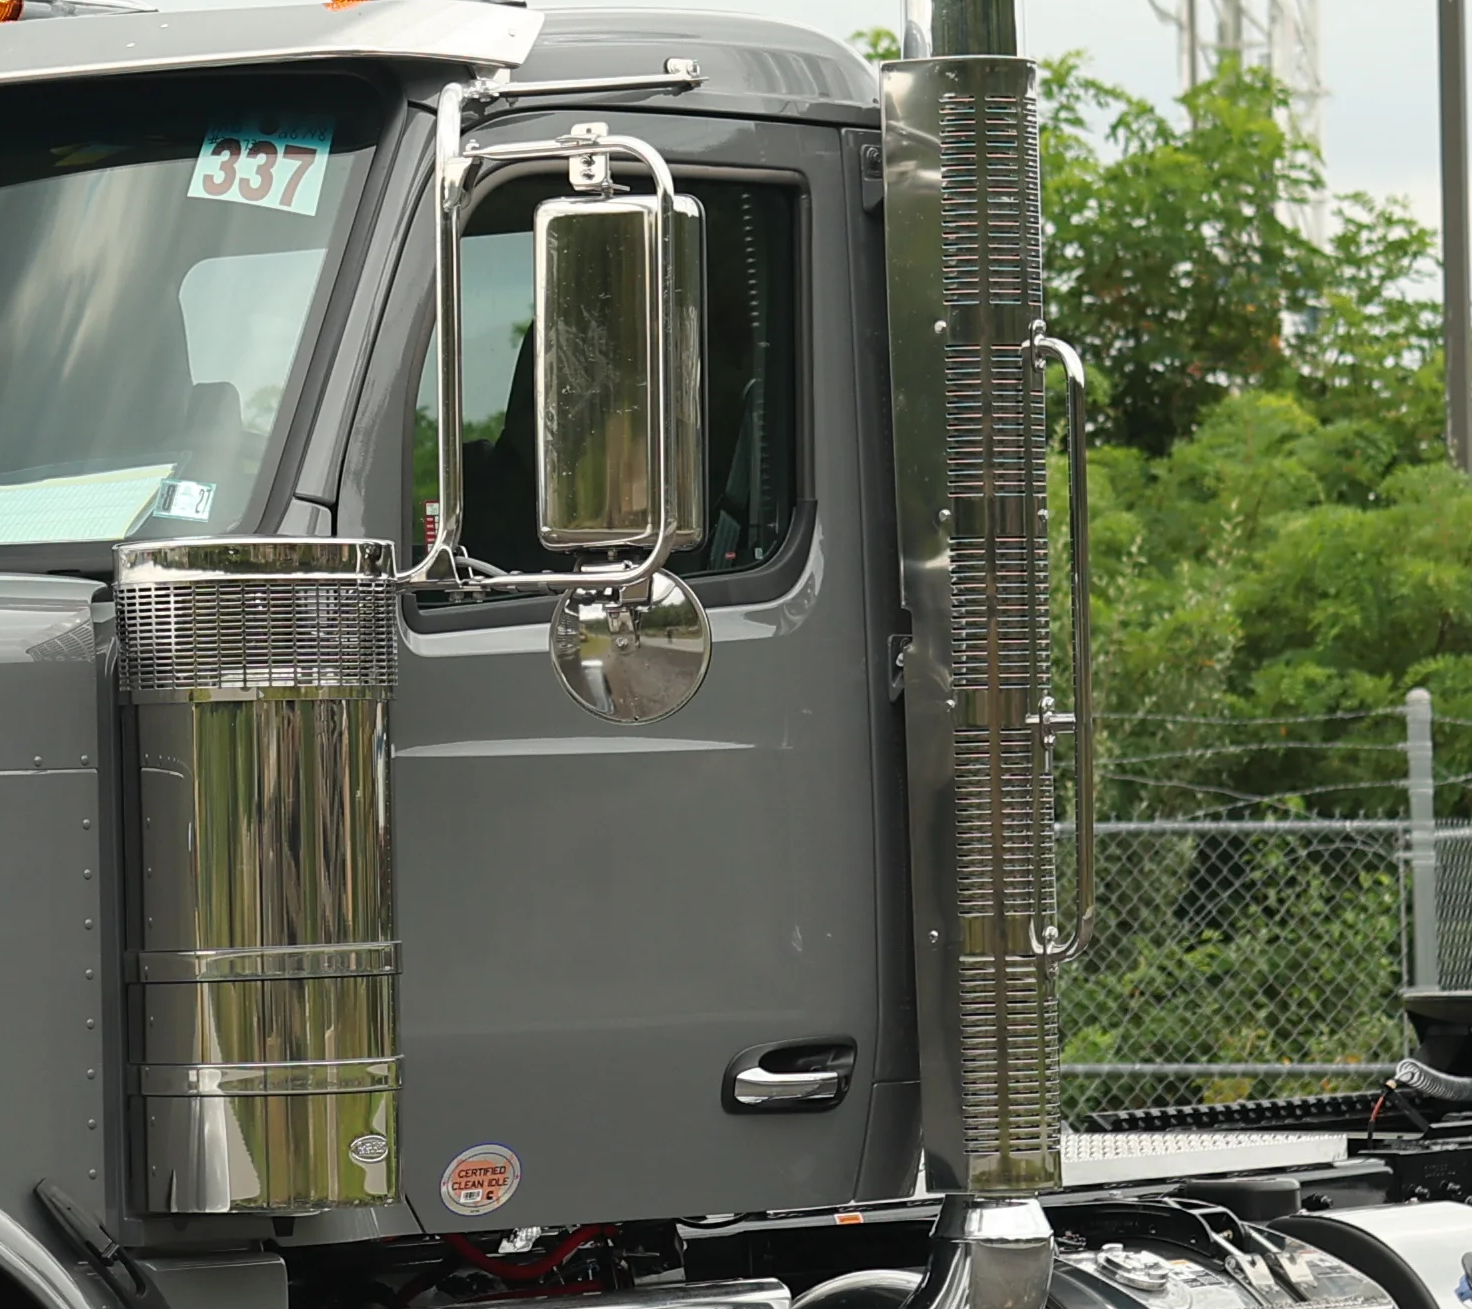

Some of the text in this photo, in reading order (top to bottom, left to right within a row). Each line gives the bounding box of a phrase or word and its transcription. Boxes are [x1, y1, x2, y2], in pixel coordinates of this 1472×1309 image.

[202, 137, 318, 208] 337
[457, 1165, 507, 1179] CERTIFIED
[451, 1176, 510, 1191] CLEAN IDLE
